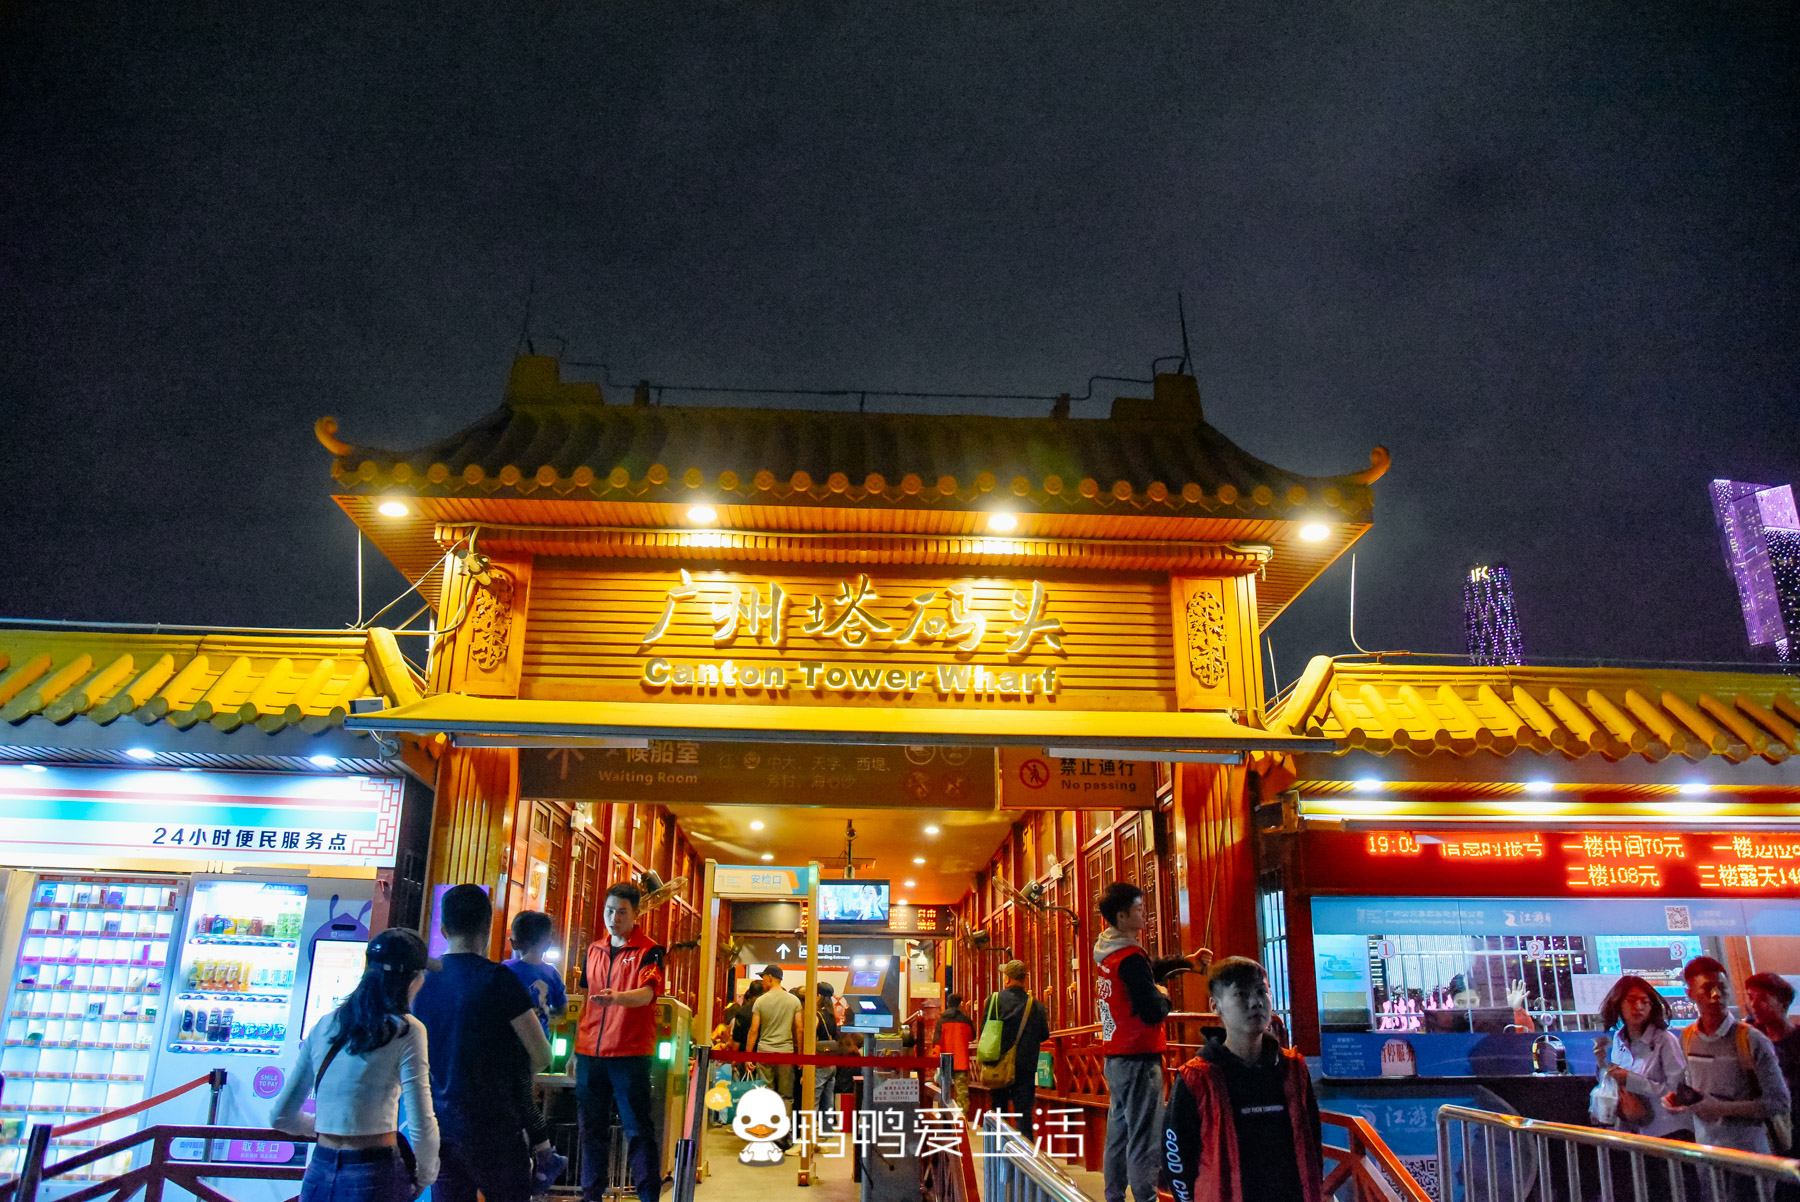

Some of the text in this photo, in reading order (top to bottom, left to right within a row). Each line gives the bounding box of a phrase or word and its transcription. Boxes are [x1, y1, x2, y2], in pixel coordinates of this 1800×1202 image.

[1471, 566, 1490, 582] IFC
[642, 568, 1062, 653] 广州塔码头
[643, 657, 1058, 693] Canton Tower Wharf
[1060, 758, 1135, 776] 禁止通行
[598, 770, 698, 785] Waiting Room
[1061, 780, 1136, 792] No passing
[152, 827, 347, 850] 24小时便民服务点
[1563, 835, 1685, 858] 一楼中间70元
[751, 874, 782, 884] 安检口
[1568, 864, 1660, 887] 二楼108元
[242, 1142, 280, 1152] 取货口
[1166, 1128, 1183, 1173] GOOD
